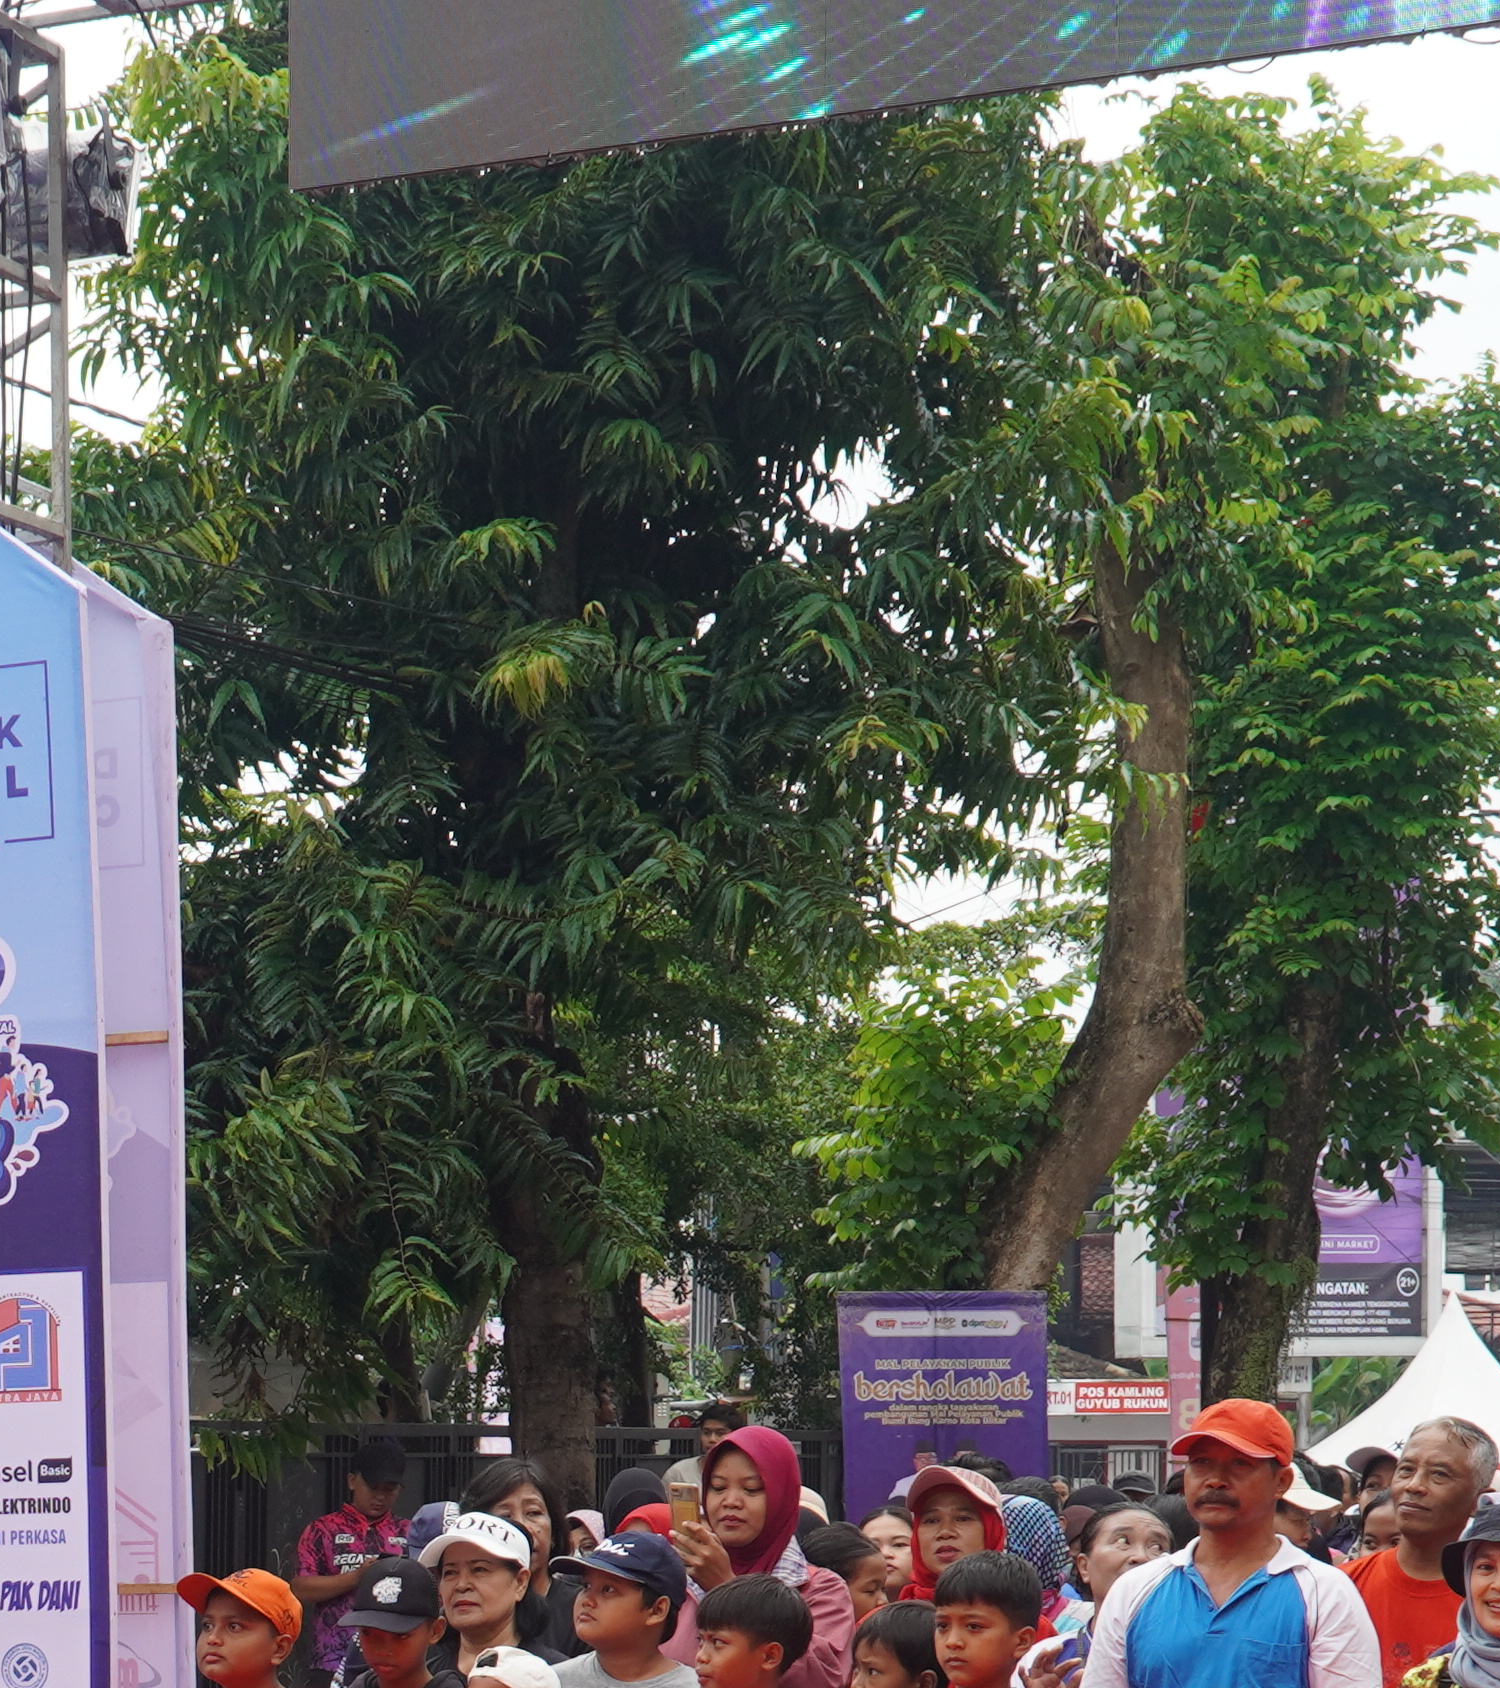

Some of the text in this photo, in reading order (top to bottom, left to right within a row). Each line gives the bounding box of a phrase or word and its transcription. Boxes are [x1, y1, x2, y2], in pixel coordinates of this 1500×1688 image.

[1336, 1240, 1374, 1249] MARKET
[1315, 1281, 1370, 1295] NGATAN:
[1400, 1277, 1415, 1288] 21+
[875, 1358, 1011, 1370] MAL PELAYANAN PUBLIK
[853, 1370, 1033, 1401] bersholawat
[26, 1392, 59, 1402] JAYA
[1079, 1386, 1165, 1398] POS KAMLING
[1076, 1398, 1167, 1409] GUYUB RUKUN
[995, 1409, 1023, 1418] Publik
[40, 1464, 70, 1477] Basic
[10, 1529, 66, 1545] PERKASA
[0, 1580, 34, 1612] PAK
[37, 1579, 81, 1612] DANI
